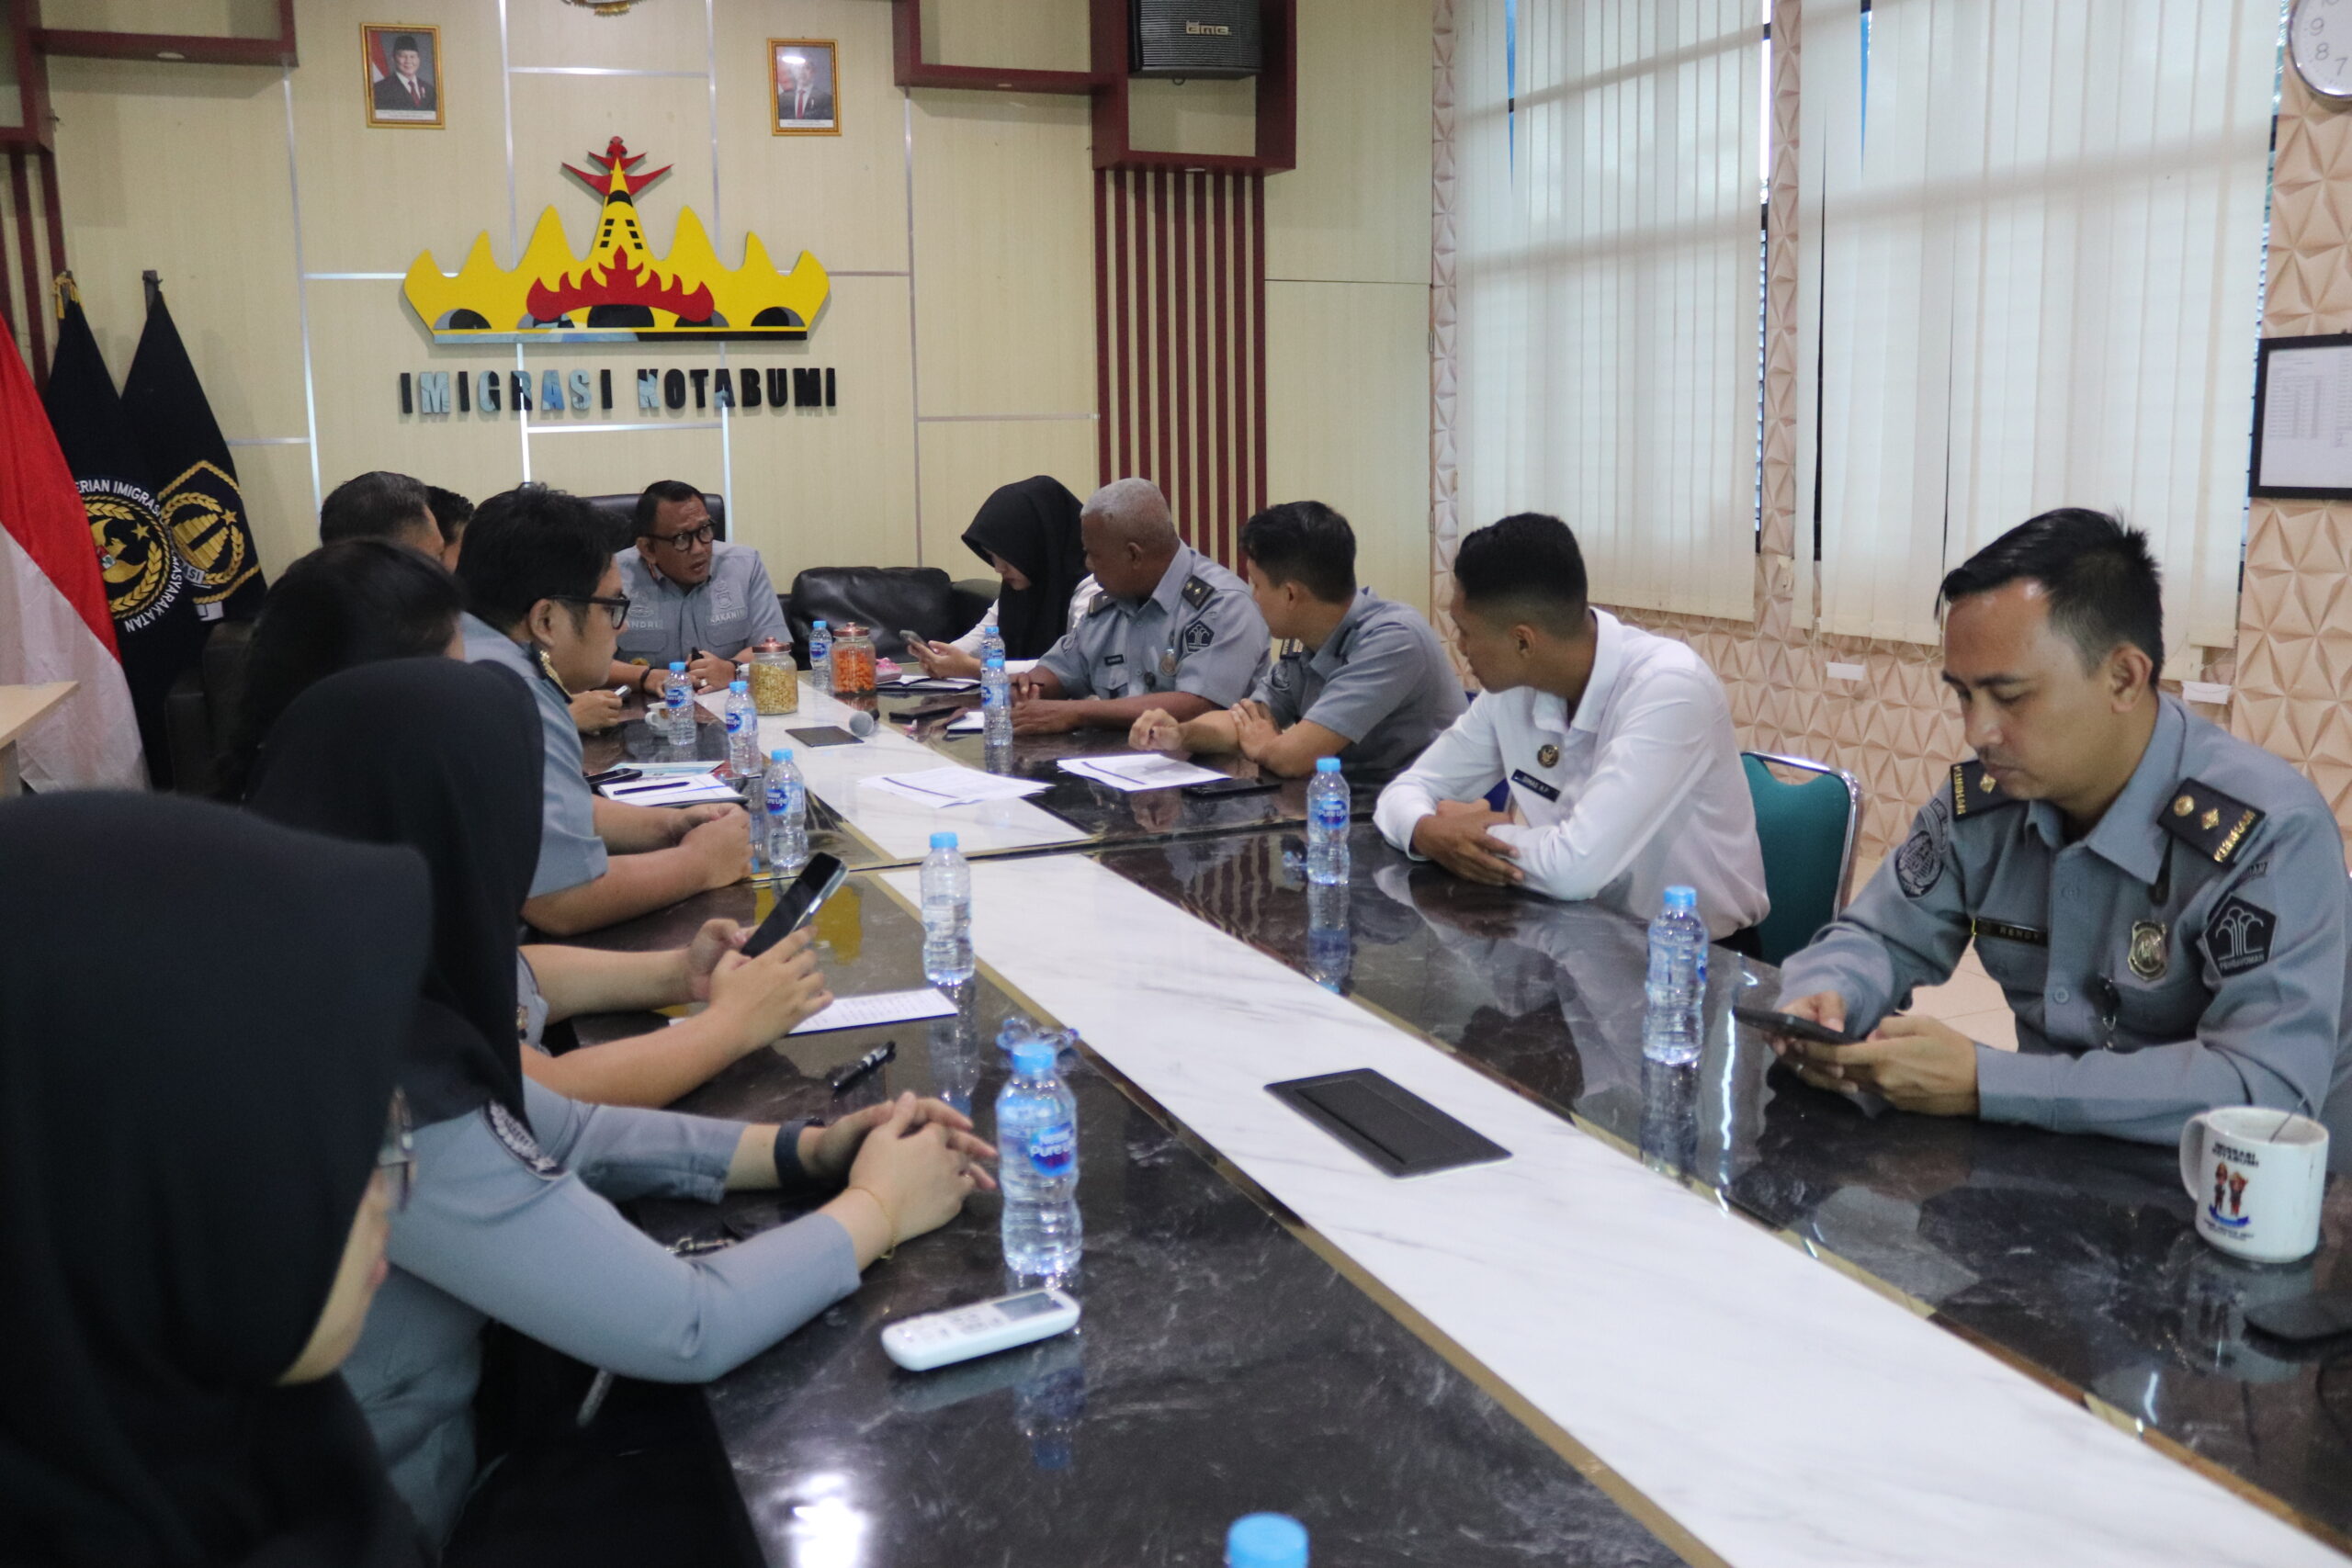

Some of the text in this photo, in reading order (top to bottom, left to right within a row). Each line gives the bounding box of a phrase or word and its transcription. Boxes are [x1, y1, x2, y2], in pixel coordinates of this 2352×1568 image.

[2310, 17, 2324, 37] 9
[2315, 42, 2329, 62] 8
[2335, 57, 2348, 76] 7
[399, 367, 836, 414] IMIGRASI KOTABUMI
